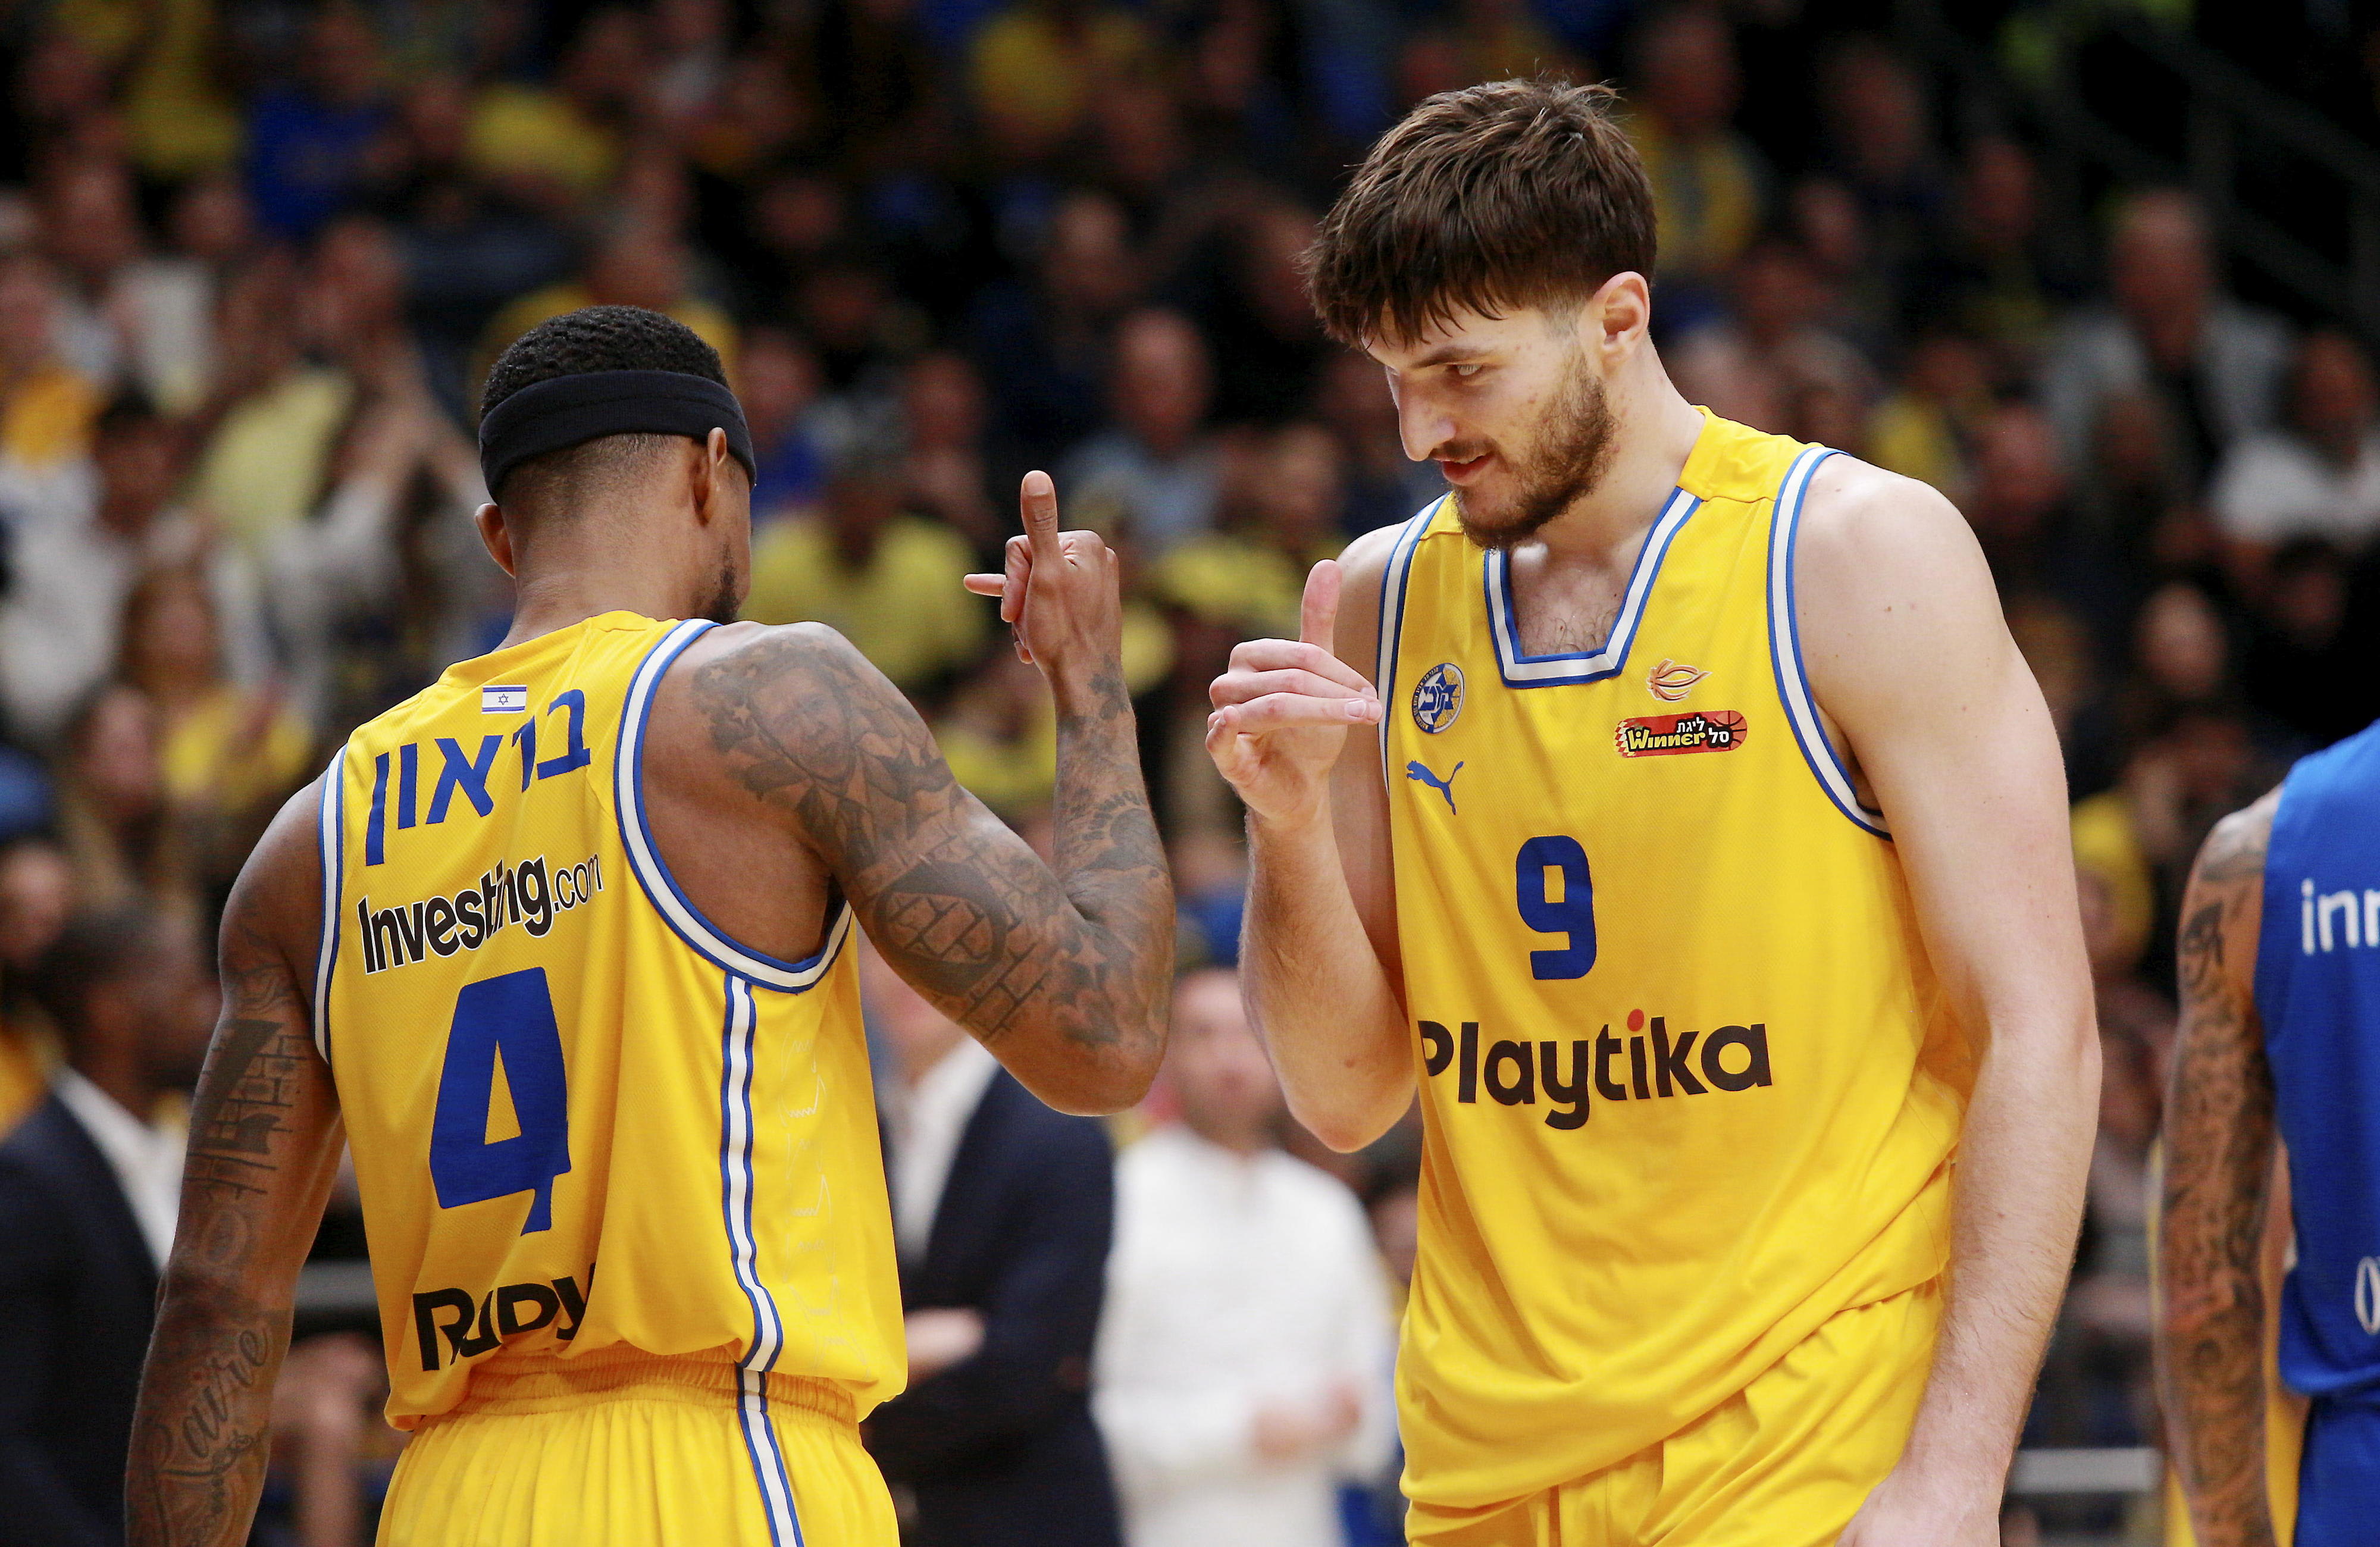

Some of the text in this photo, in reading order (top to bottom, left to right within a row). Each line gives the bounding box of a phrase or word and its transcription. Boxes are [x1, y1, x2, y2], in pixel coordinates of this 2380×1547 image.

[1627, 729, 1706, 750] Winner
[1677, 716, 1705, 733] ליגת
[1708, 727, 1730, 743] סל
[357, 853, 605, 975] Investing.com
[1516, 835, 1597, 981] 9
[429, 966, 571, 1237] 4
[1417, 1009, 1773, 1130] Playtika
